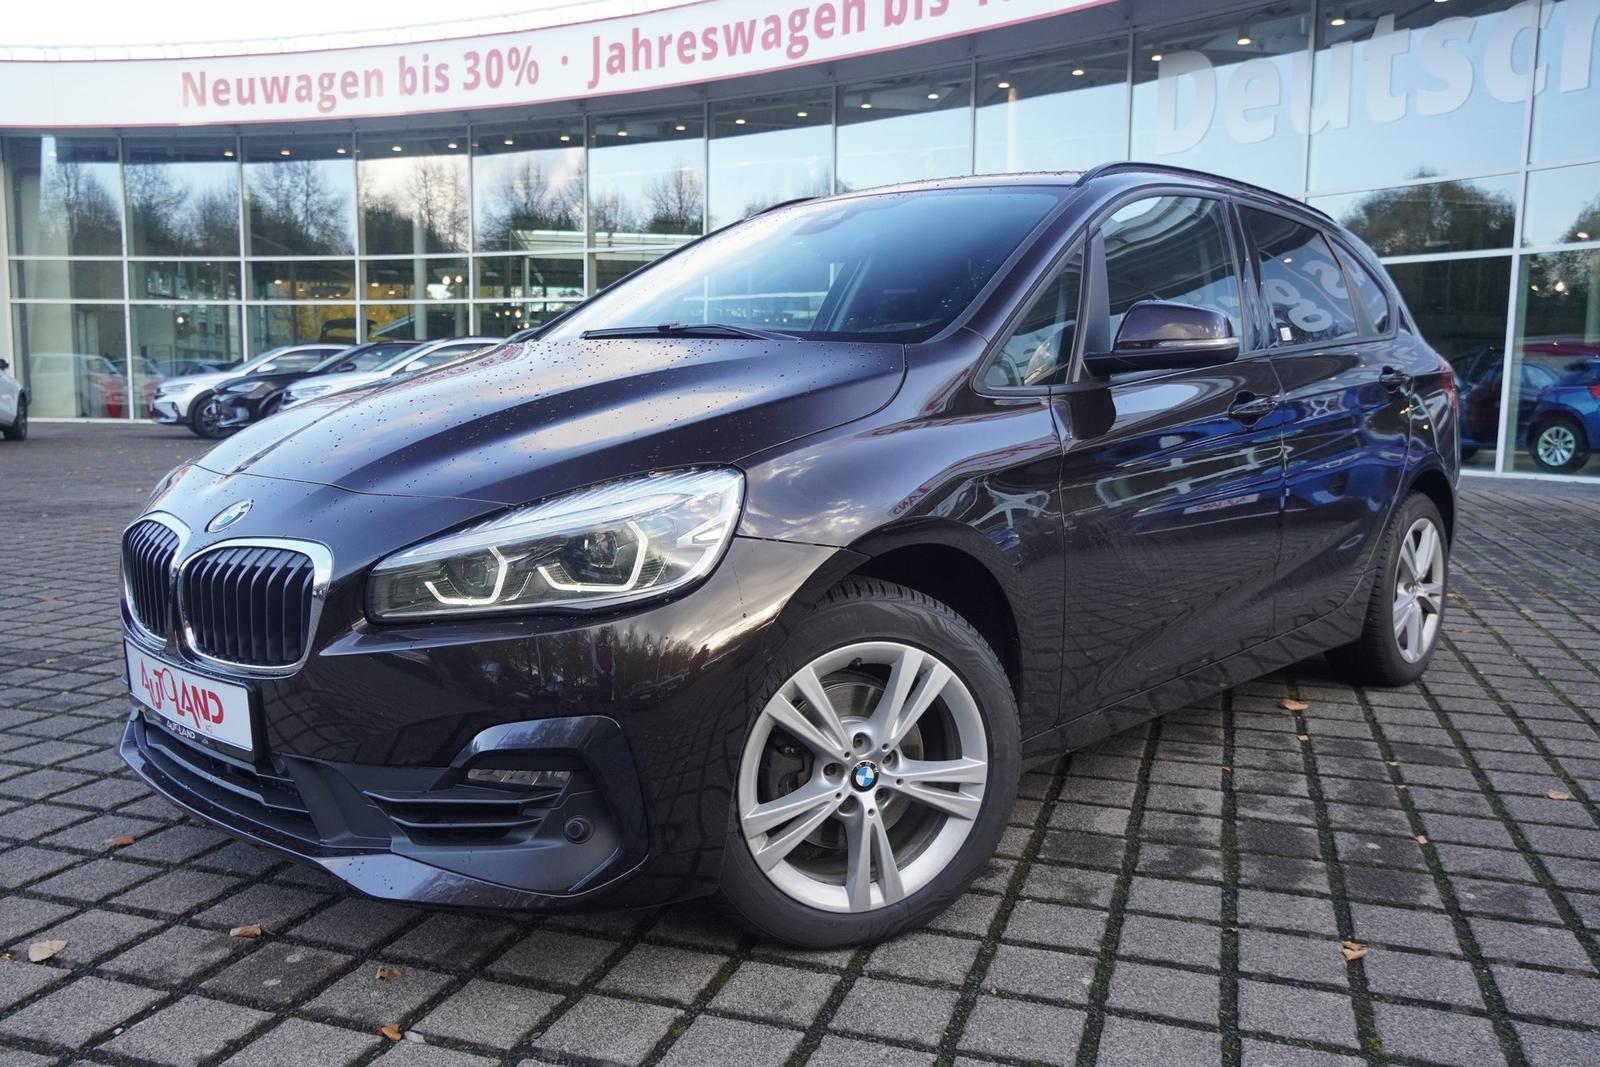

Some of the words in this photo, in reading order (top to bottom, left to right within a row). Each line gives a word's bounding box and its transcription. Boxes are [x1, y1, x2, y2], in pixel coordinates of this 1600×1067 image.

[181, 67, 384, 113] Neuwagen
[398, 53, 450, 96] bis
[463, 45, 539, 91] 30%
[587, 0, 866, 90] Jahreswagen
